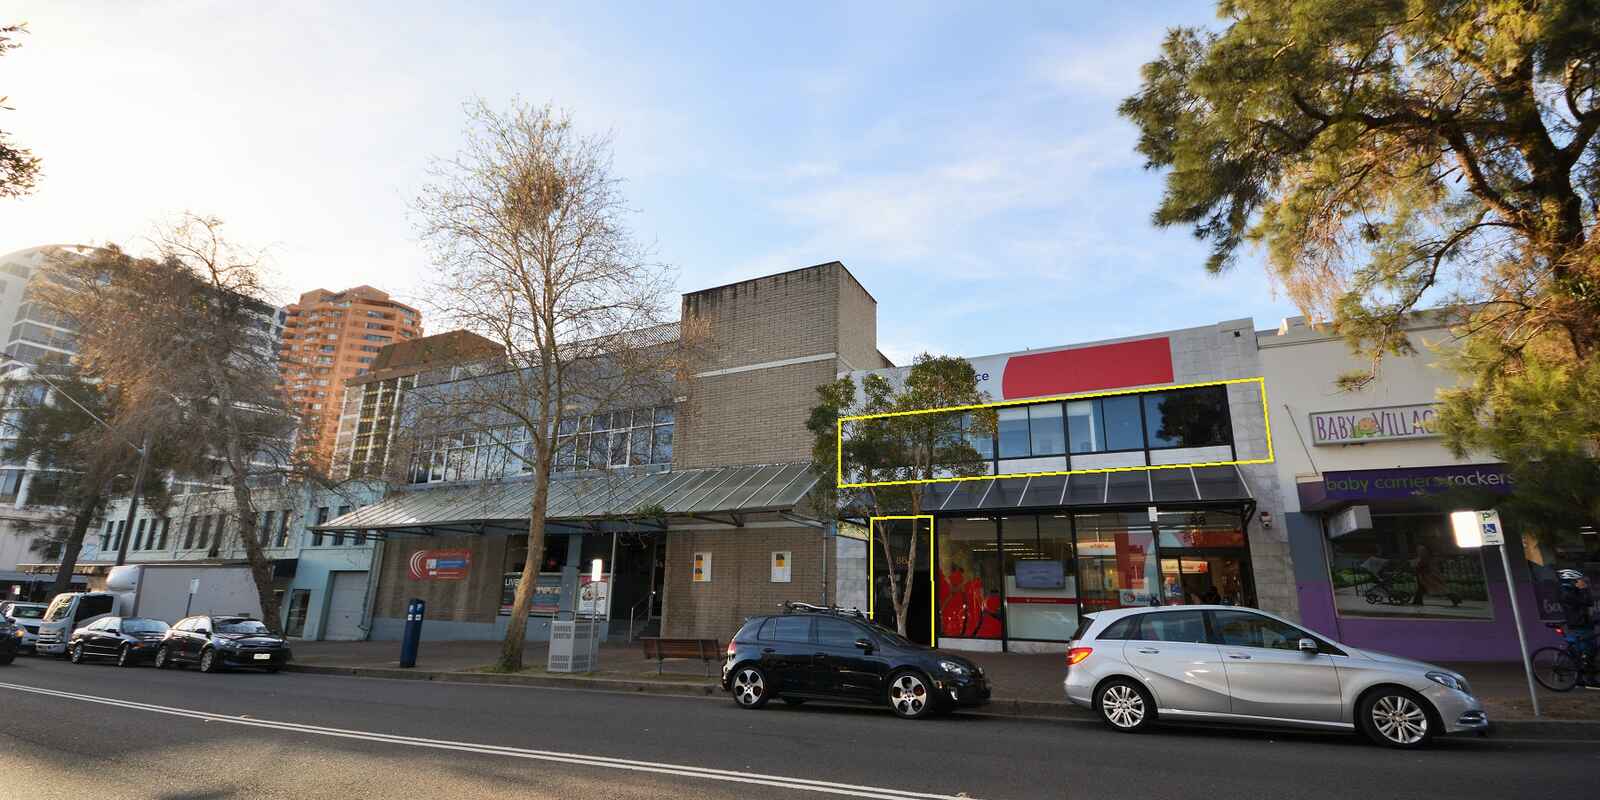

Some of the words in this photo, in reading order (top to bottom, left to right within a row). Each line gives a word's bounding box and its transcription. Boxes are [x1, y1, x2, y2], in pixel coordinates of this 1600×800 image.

[1316, 415, 1355, 441] BABY
[1372, 407, 1436, 437] VILLAG
[1327, 476, 1368, 493] baby
[1448, 471, 1515, 487] rockers
